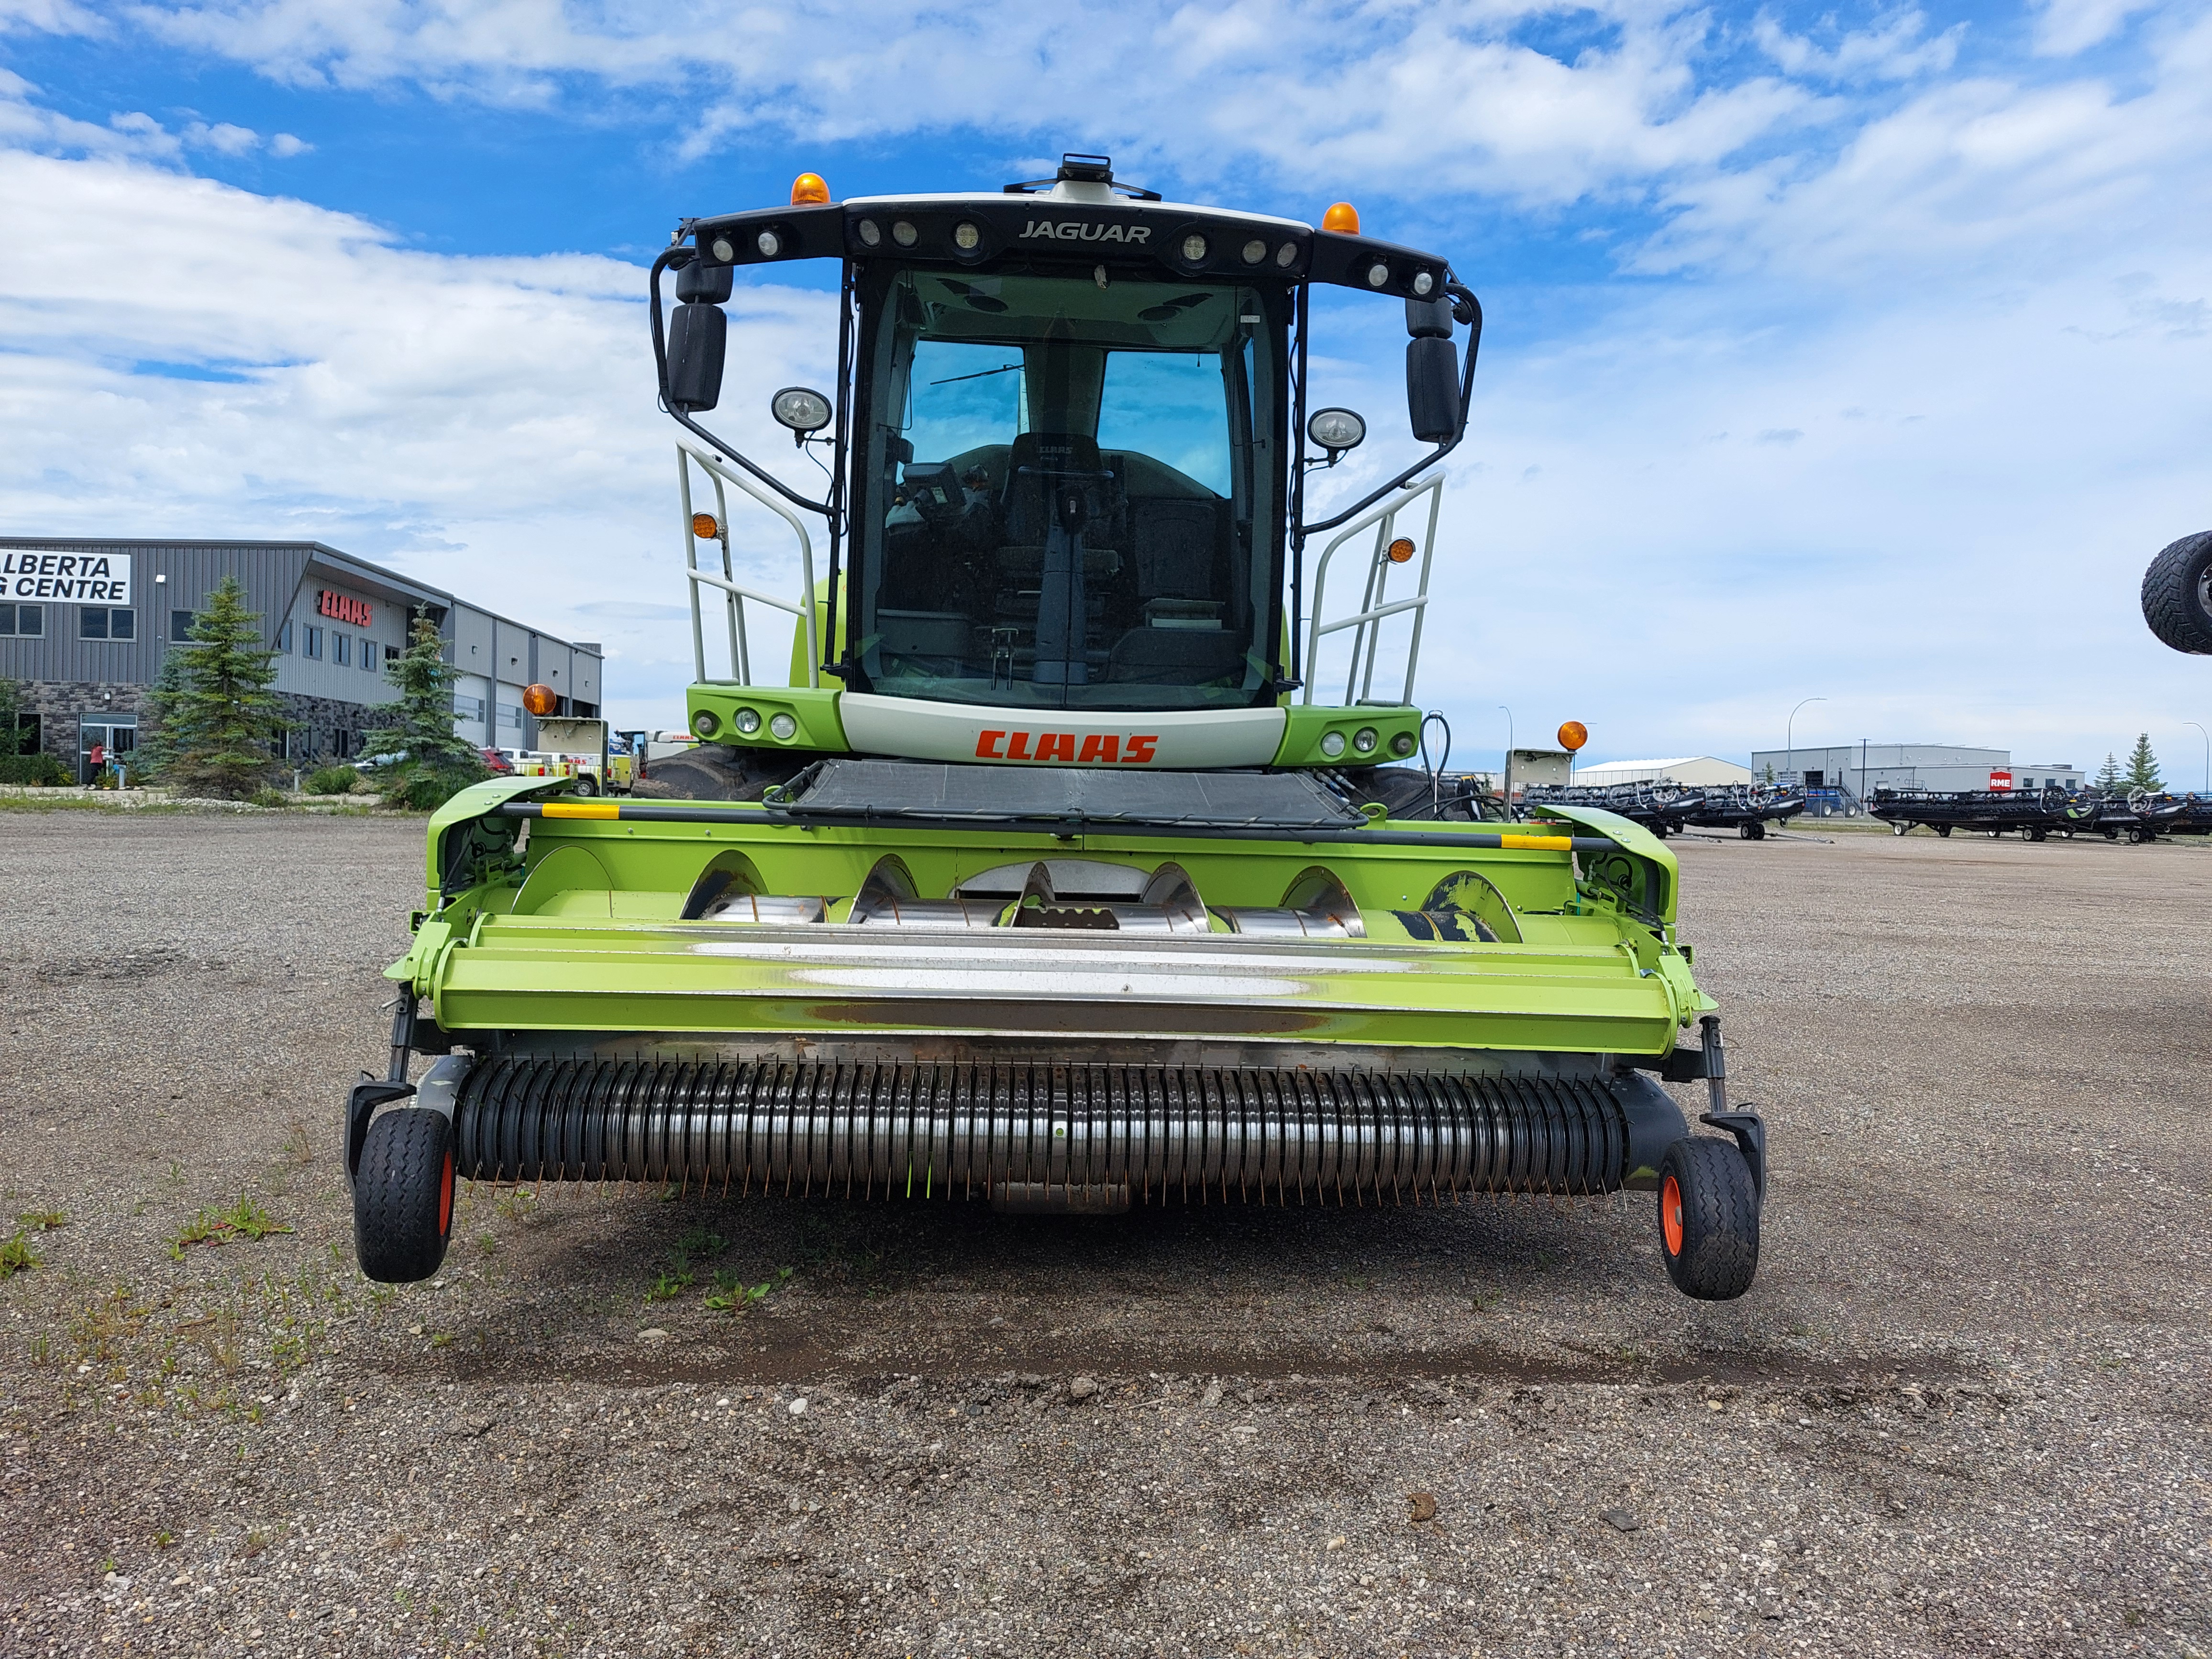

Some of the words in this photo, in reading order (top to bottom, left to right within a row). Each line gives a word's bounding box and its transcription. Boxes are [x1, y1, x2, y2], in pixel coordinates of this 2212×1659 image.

[1019, 221, 1151, 243] JAGUAR
[0, 553, 110, 578] LBERTA
[16, 577, 126, 600] CENTRE
[321, 590, 372, 627] CLAAS
[975, 730, 1159, 763] CLAAS
